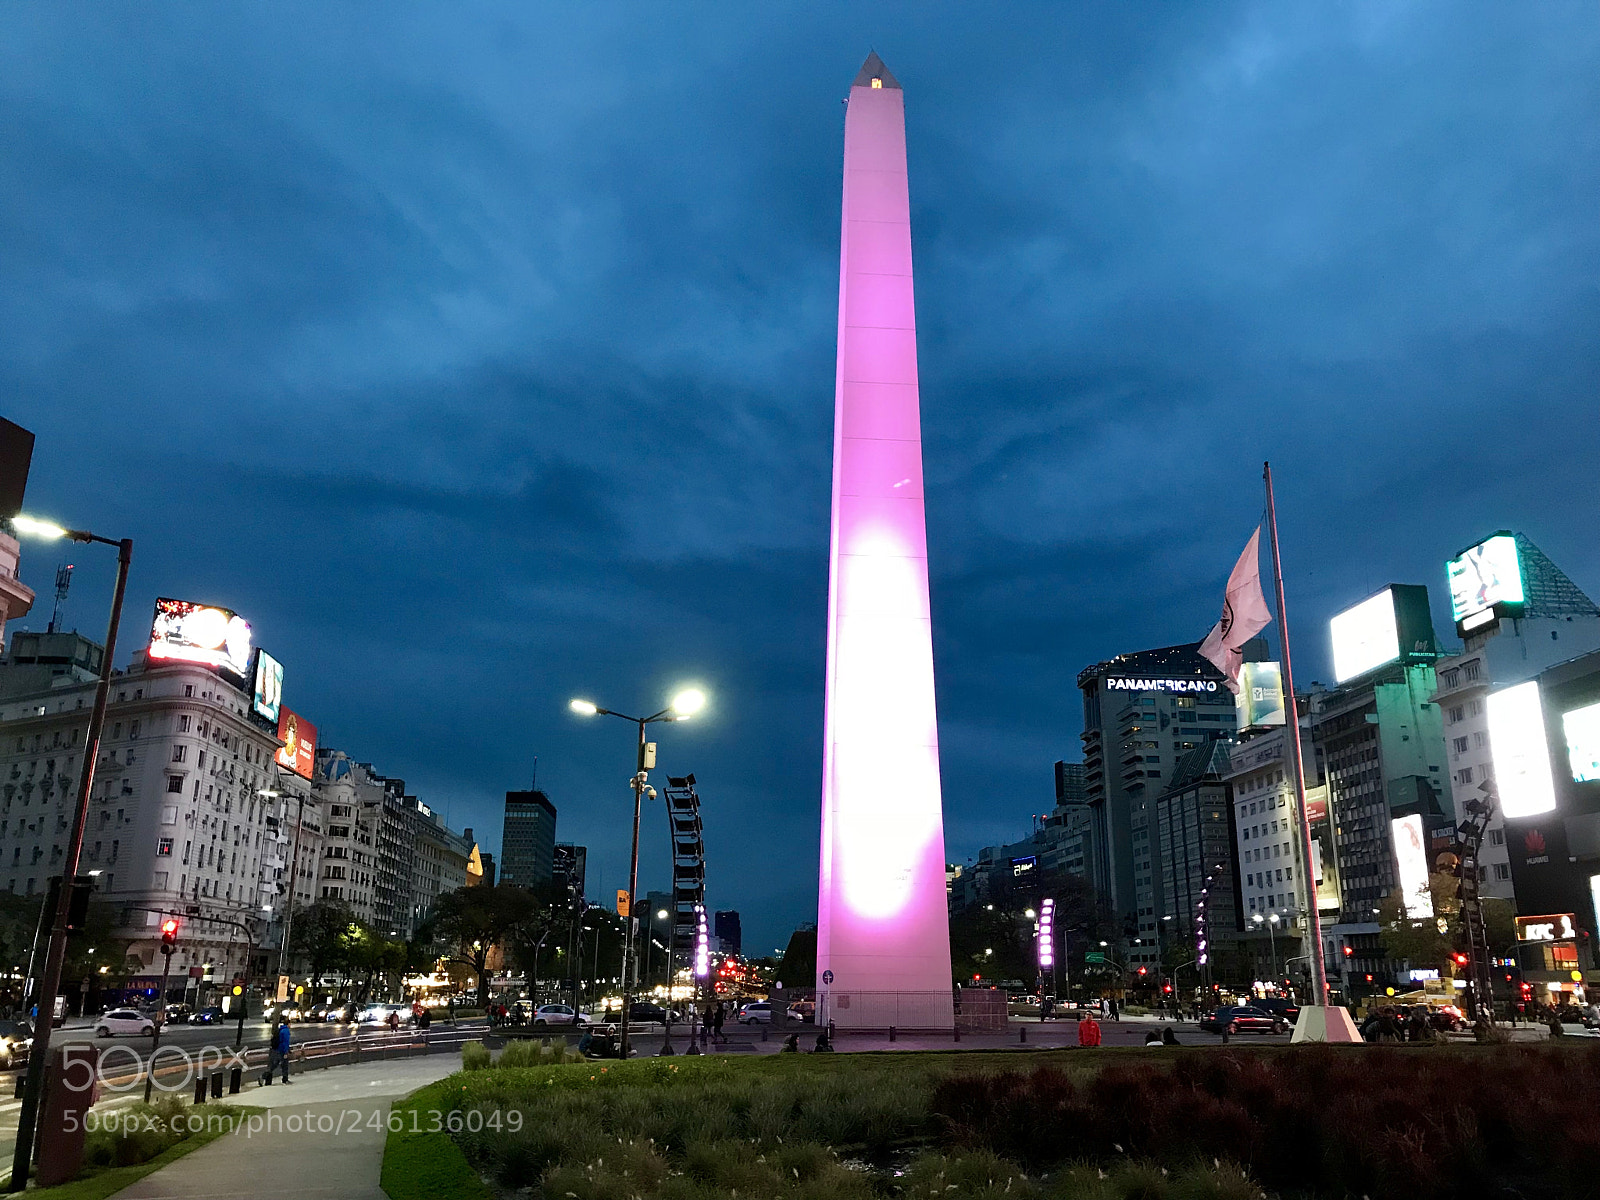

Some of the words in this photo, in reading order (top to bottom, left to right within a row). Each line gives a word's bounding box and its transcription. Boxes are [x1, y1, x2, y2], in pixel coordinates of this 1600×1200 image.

[1107, 679, 1217, 692] PANAMERICANO
[1526, 856, 1549, 865] HUAWEI
[1525, 923, 1554, 940] KFC
